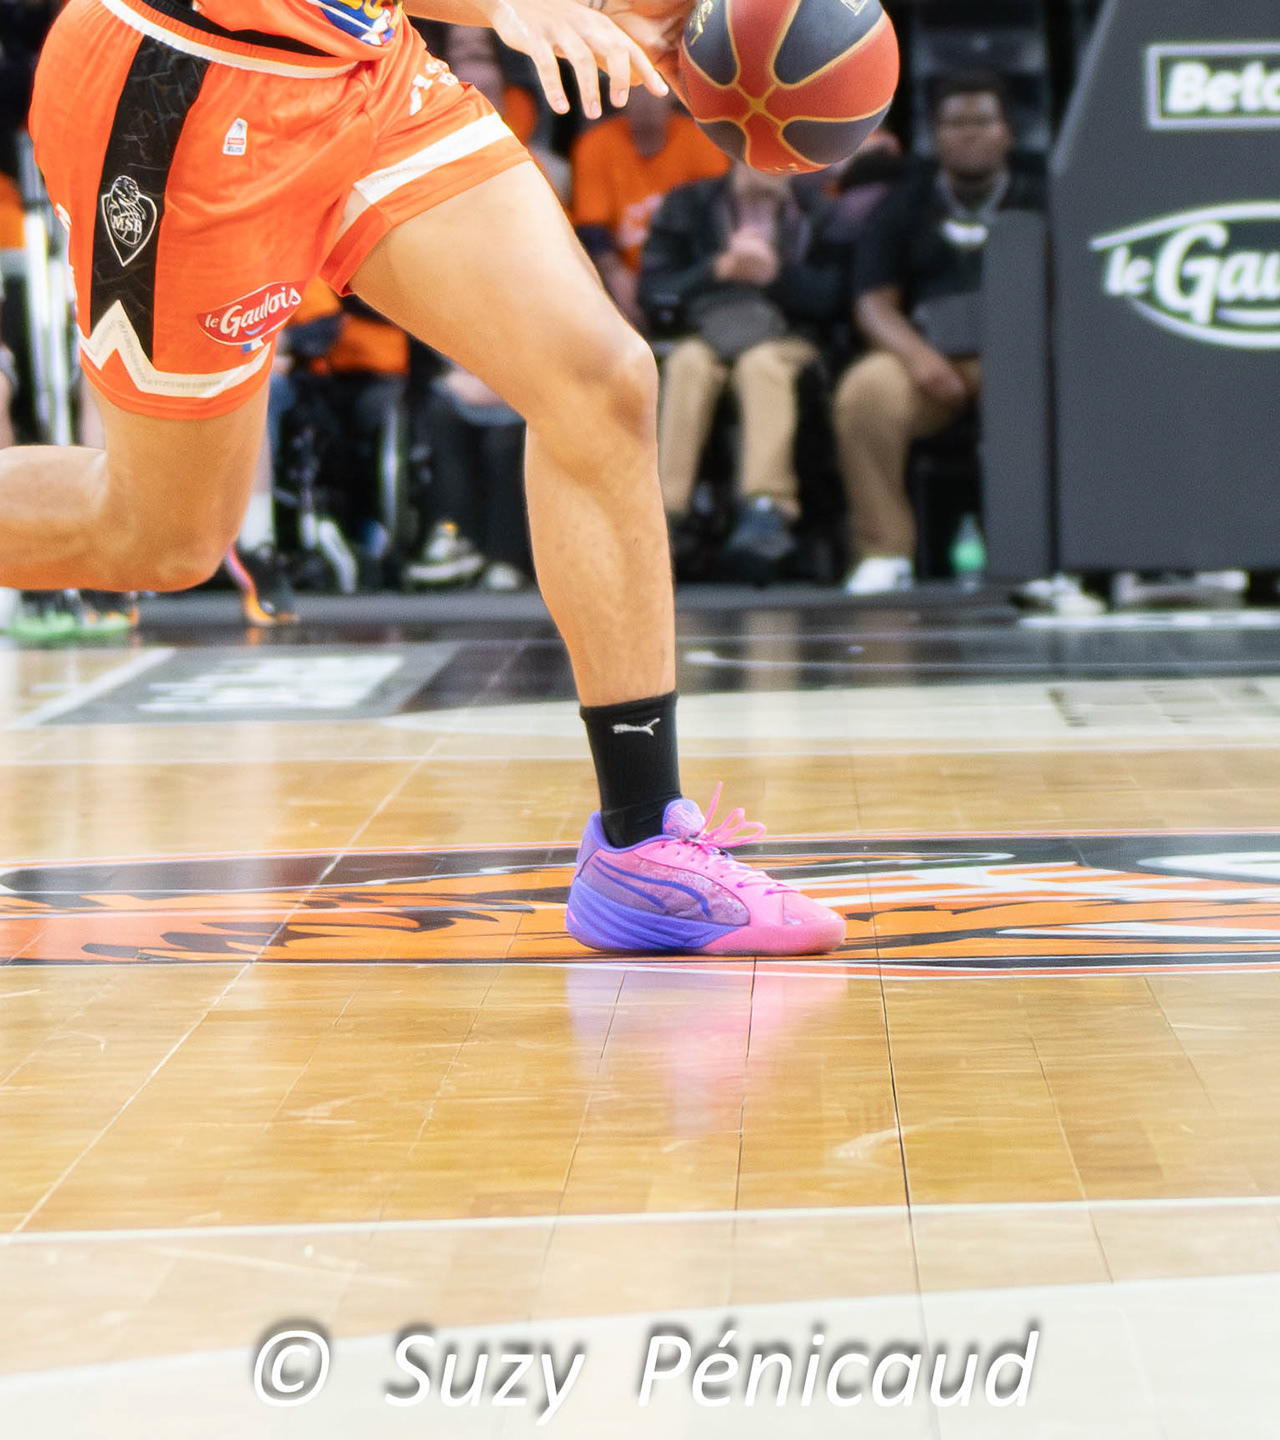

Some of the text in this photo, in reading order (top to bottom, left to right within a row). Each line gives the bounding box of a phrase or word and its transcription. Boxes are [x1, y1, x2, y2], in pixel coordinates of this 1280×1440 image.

[111, 215, 142, 234] MSB
[1105, 244, 1153, 296] le
[204, 285, 302, 338] le Gaulois
